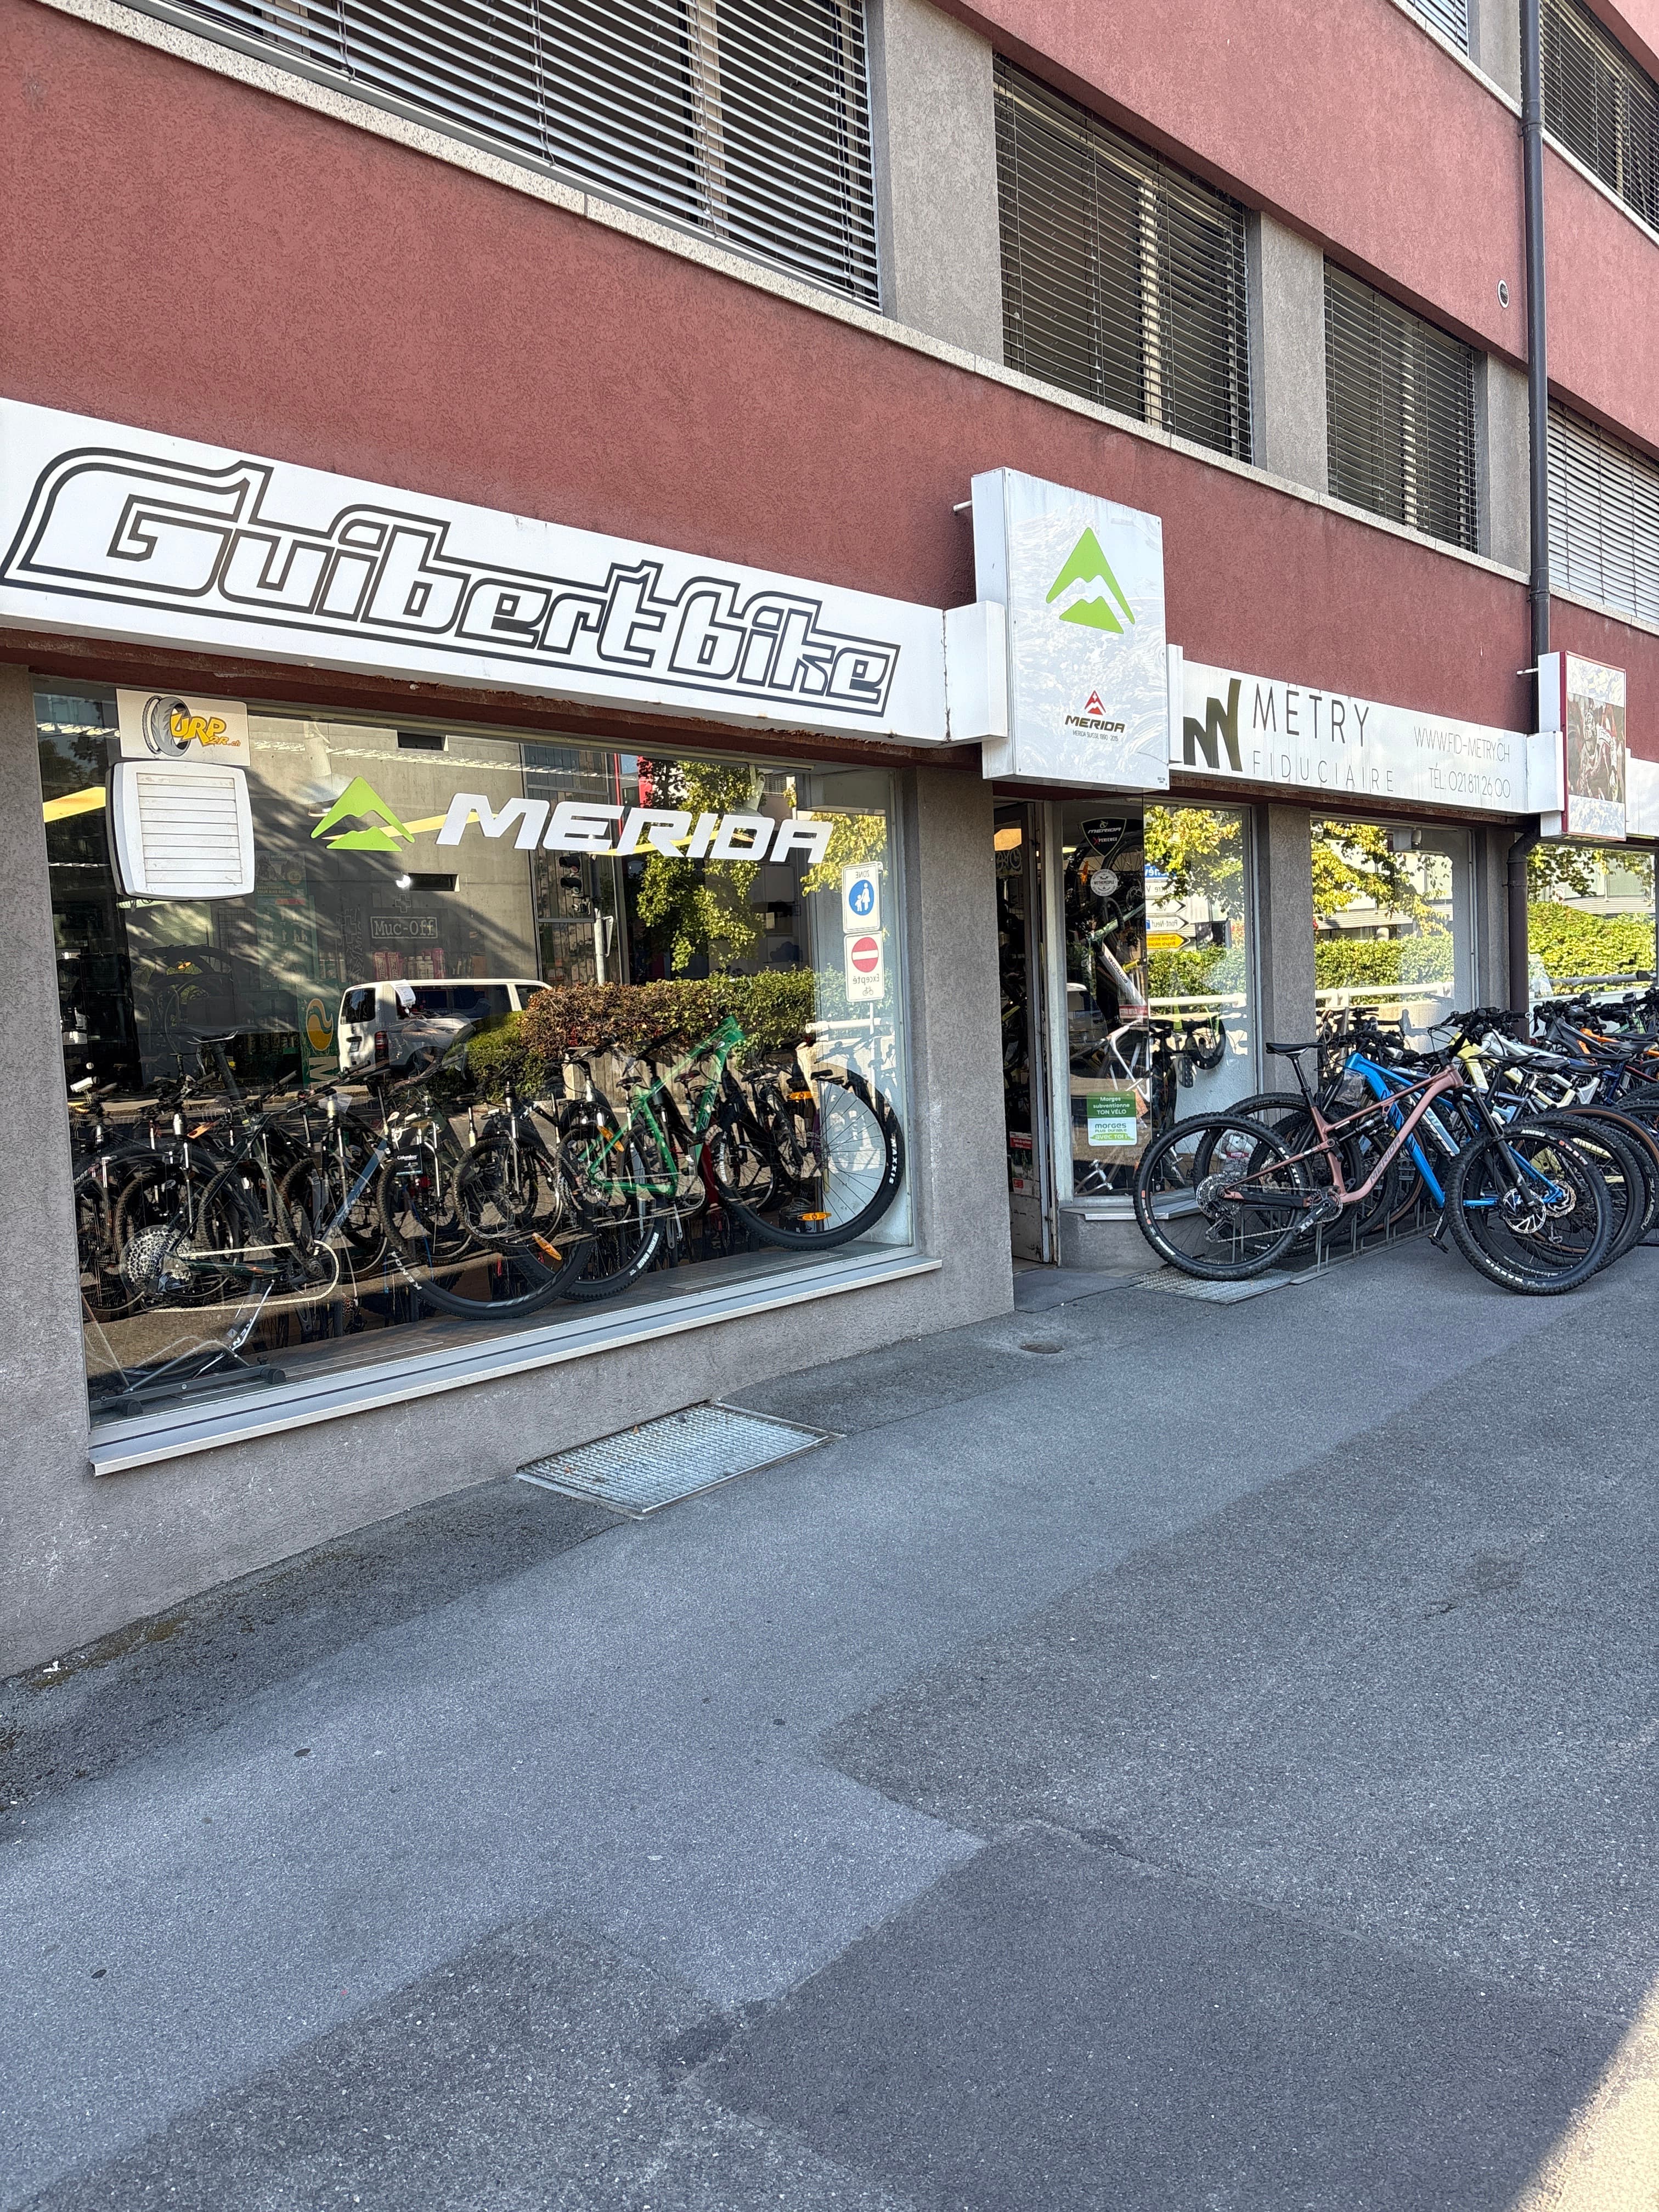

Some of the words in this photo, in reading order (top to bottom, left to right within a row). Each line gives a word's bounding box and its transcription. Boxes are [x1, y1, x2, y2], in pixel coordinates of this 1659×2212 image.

[1065, 715, 1125, 733] MERIDA
[1253, 682, 1369, 747] METRY
[1414, 726, 1510, 763] WWW.FID-METRY.CH
[1253, 751, 1394, 792] FIDUCIAIRE
[1449, 771, 1466, 792] 021
[1468, 774, 1480, 794] 811
[1482, 776, 1493, 795] 26
[1495, 778, 1510, 798] 00
[436, 793, 834, 863] MERIDA
[374, 919, 435, 936] Muc-Off
[888, 1137, 898, 1185] MAXXIS
[1370, 1136, 1401, 1184] MERIDA
[1640, 1195, 1655, 1231] NOBBY
[391, 1251, 422, 1290] KENDA
